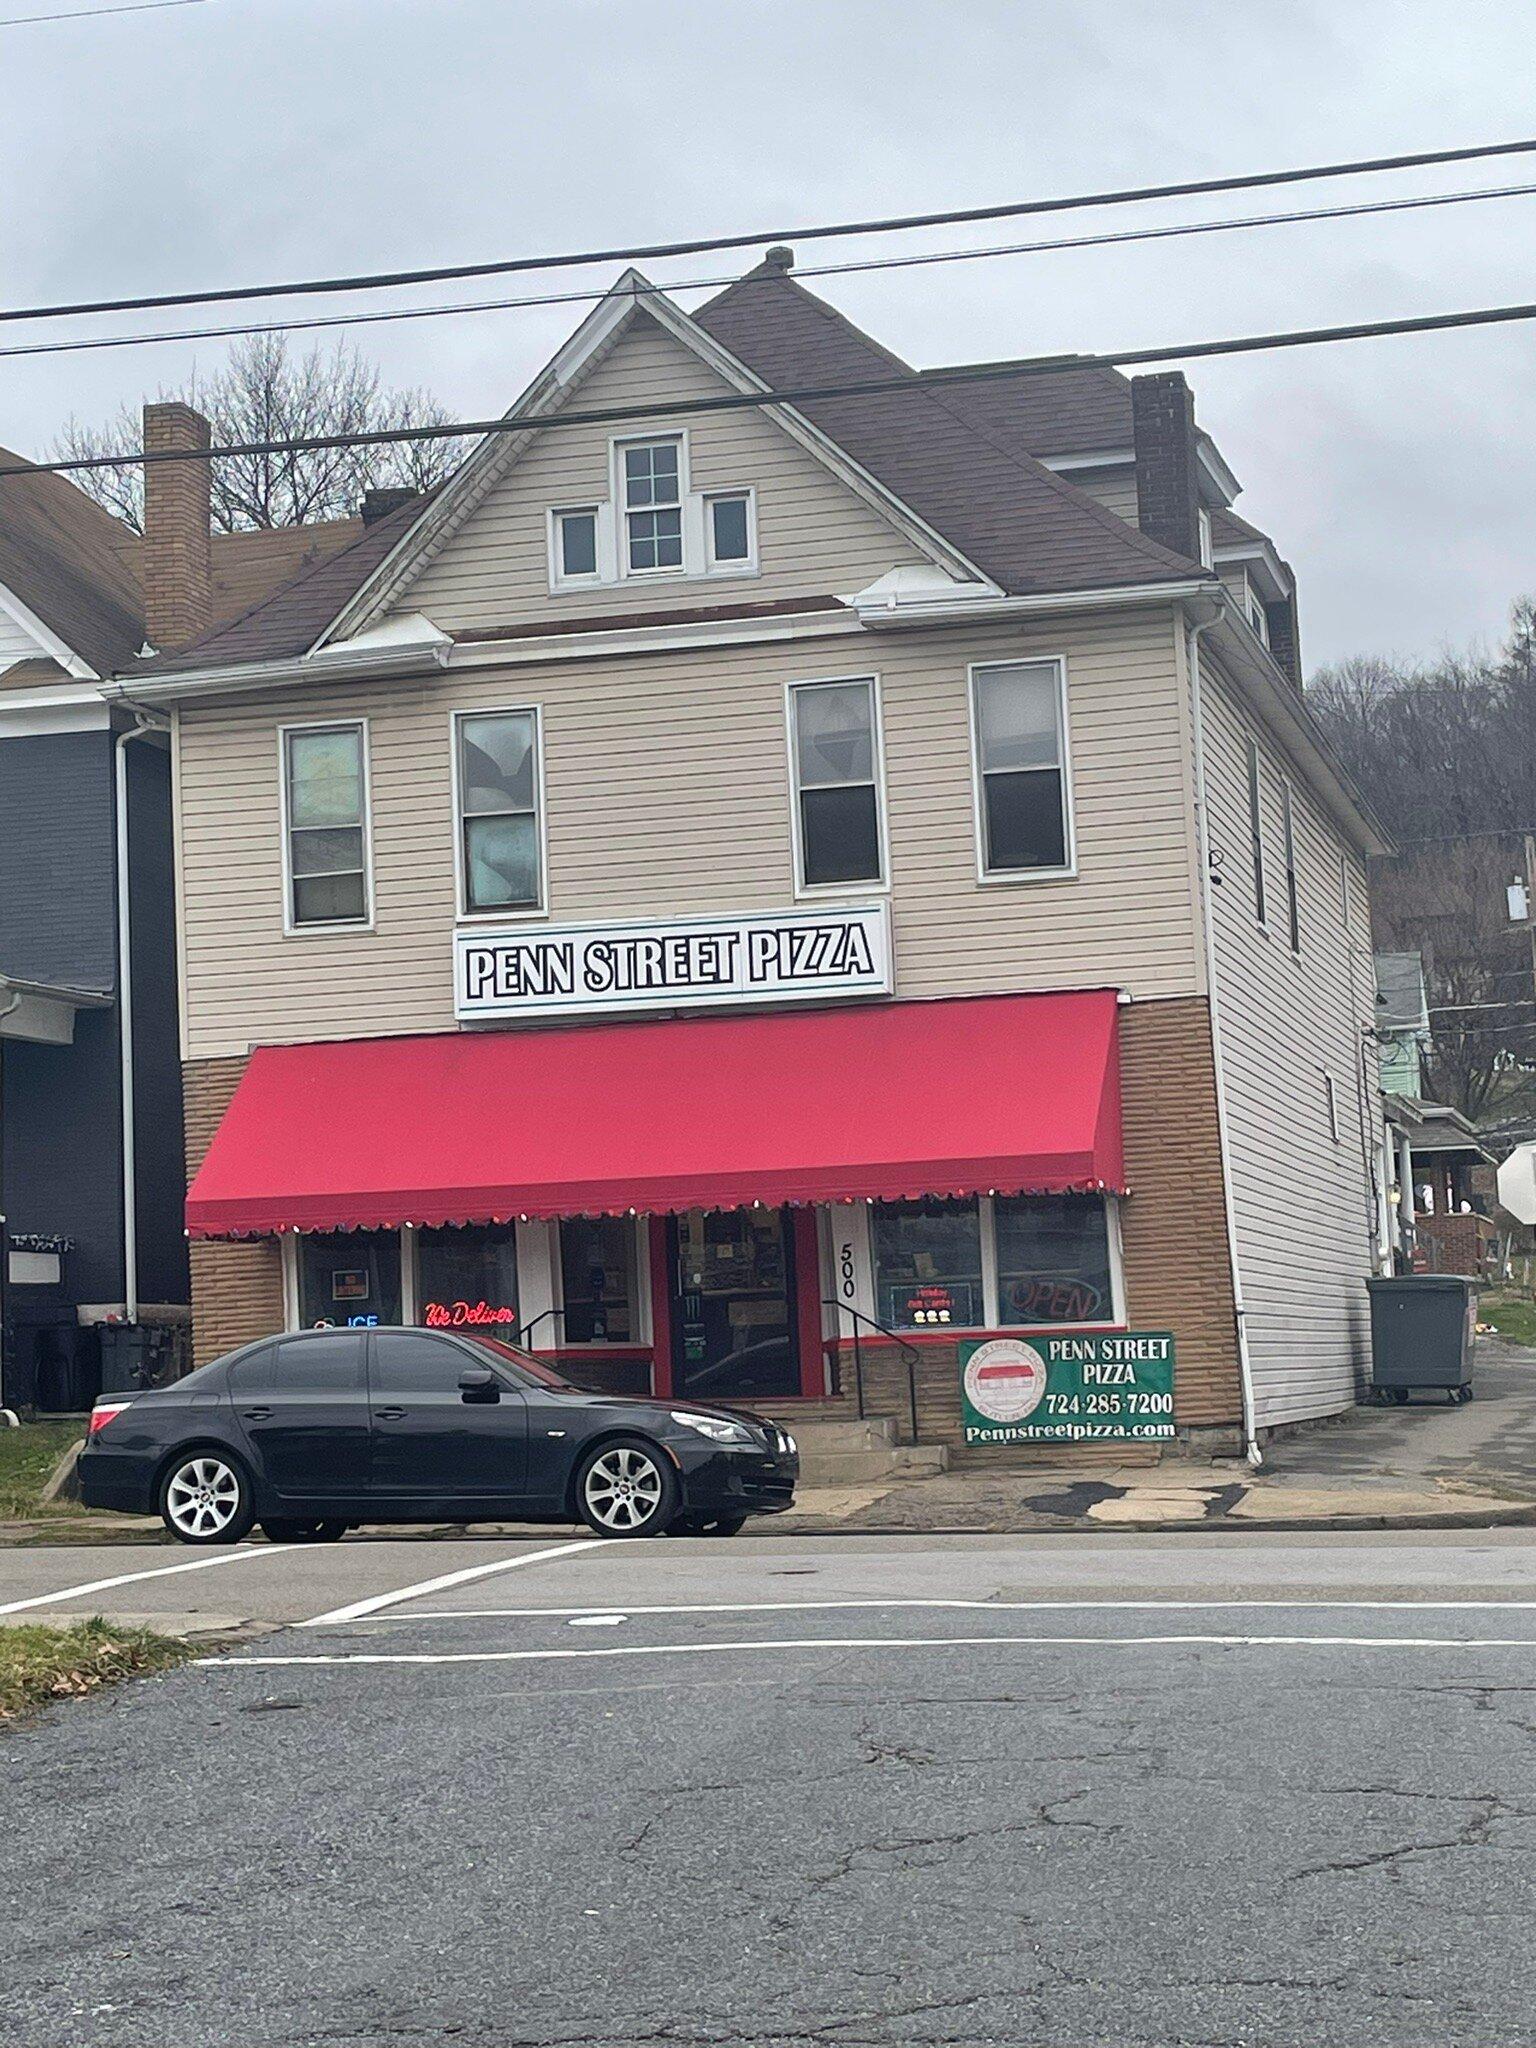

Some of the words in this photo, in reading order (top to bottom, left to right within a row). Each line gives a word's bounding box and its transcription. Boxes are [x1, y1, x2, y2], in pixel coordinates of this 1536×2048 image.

[466, 943, 575, 999] PENN
[583, 931, 740, 991] STREET
[747, 922, 875, 982] PIZZA
[841, 1243, 854, 1298] 500
[1010, 1280, 1093, 1319] OPEN
[425, 1303, 452, 1326] We
[452, 1301, 515, 1326] Deliver
[1049, 1340, 1095, 1360] PENN
[1101, 1338, 1170, 1360] STREET
[1083, 1363, 1136, 1385] PIZZA
[966, 1422, 1175, 1442] Pennstreetpizza.com
